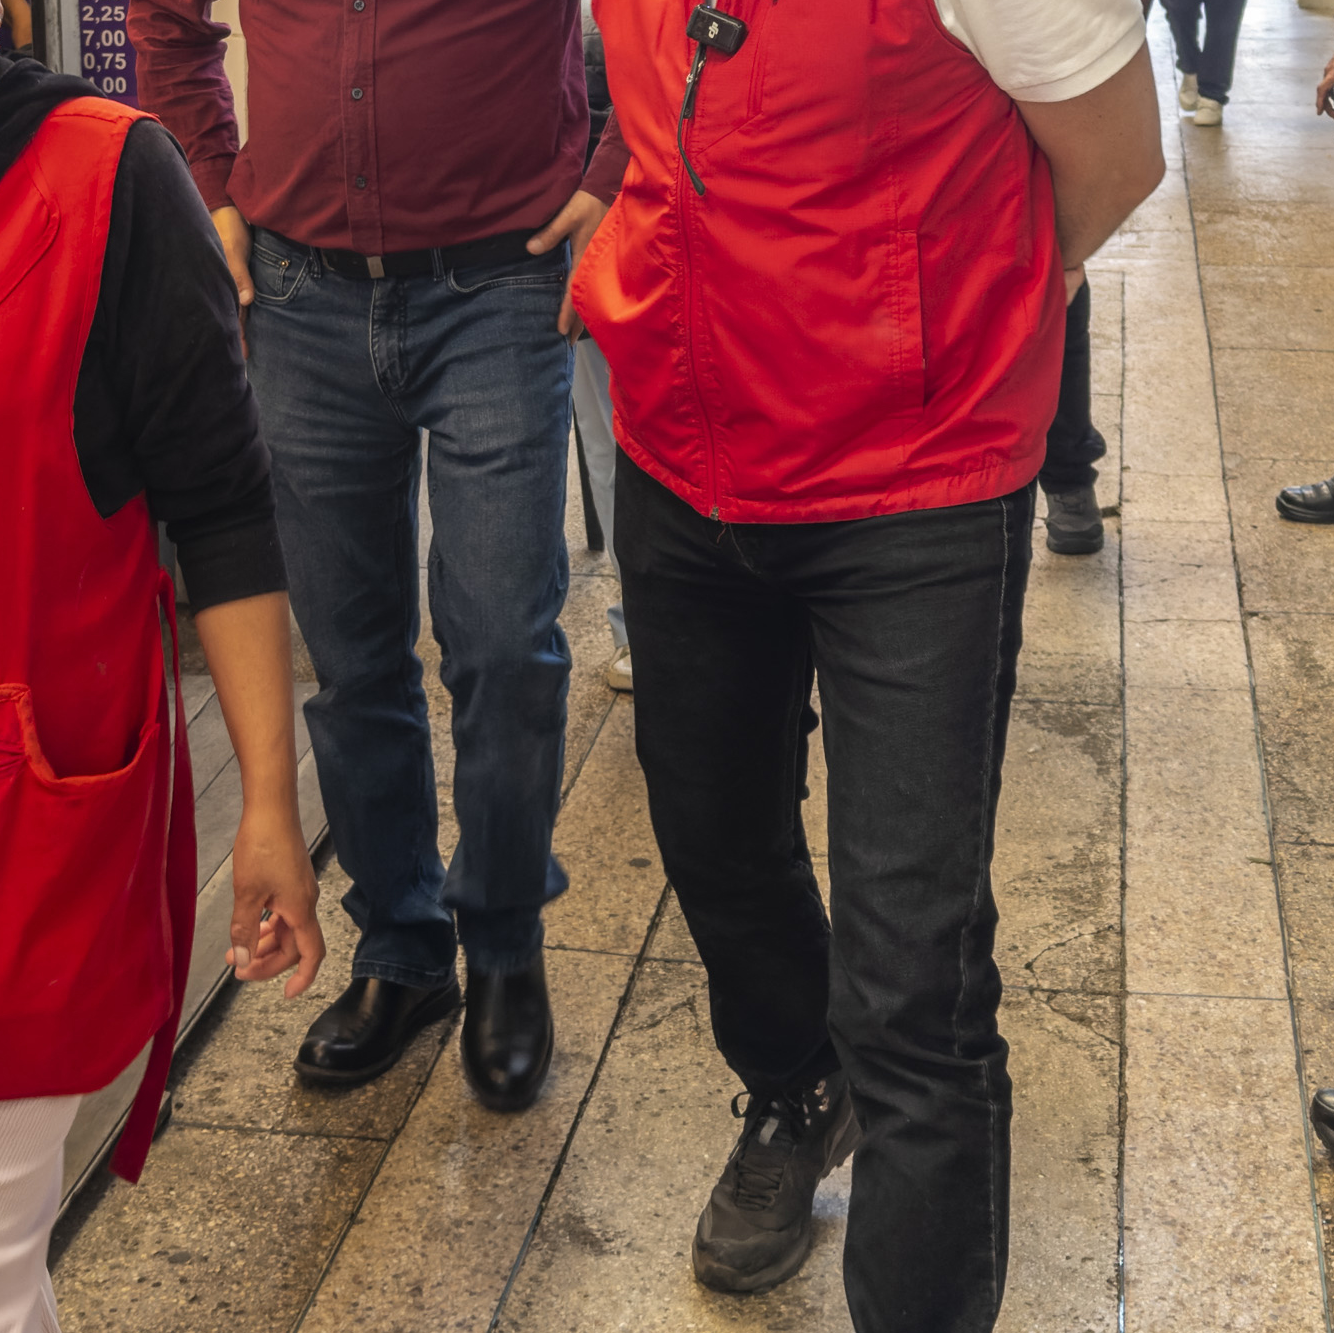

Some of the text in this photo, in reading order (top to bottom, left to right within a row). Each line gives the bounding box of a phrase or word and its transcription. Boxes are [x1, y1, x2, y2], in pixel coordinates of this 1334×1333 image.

[82, 6, 125, 24] 2,25
[83, 30, 125, 49] 7,00
[84, 53, 126, 72] 0,75
